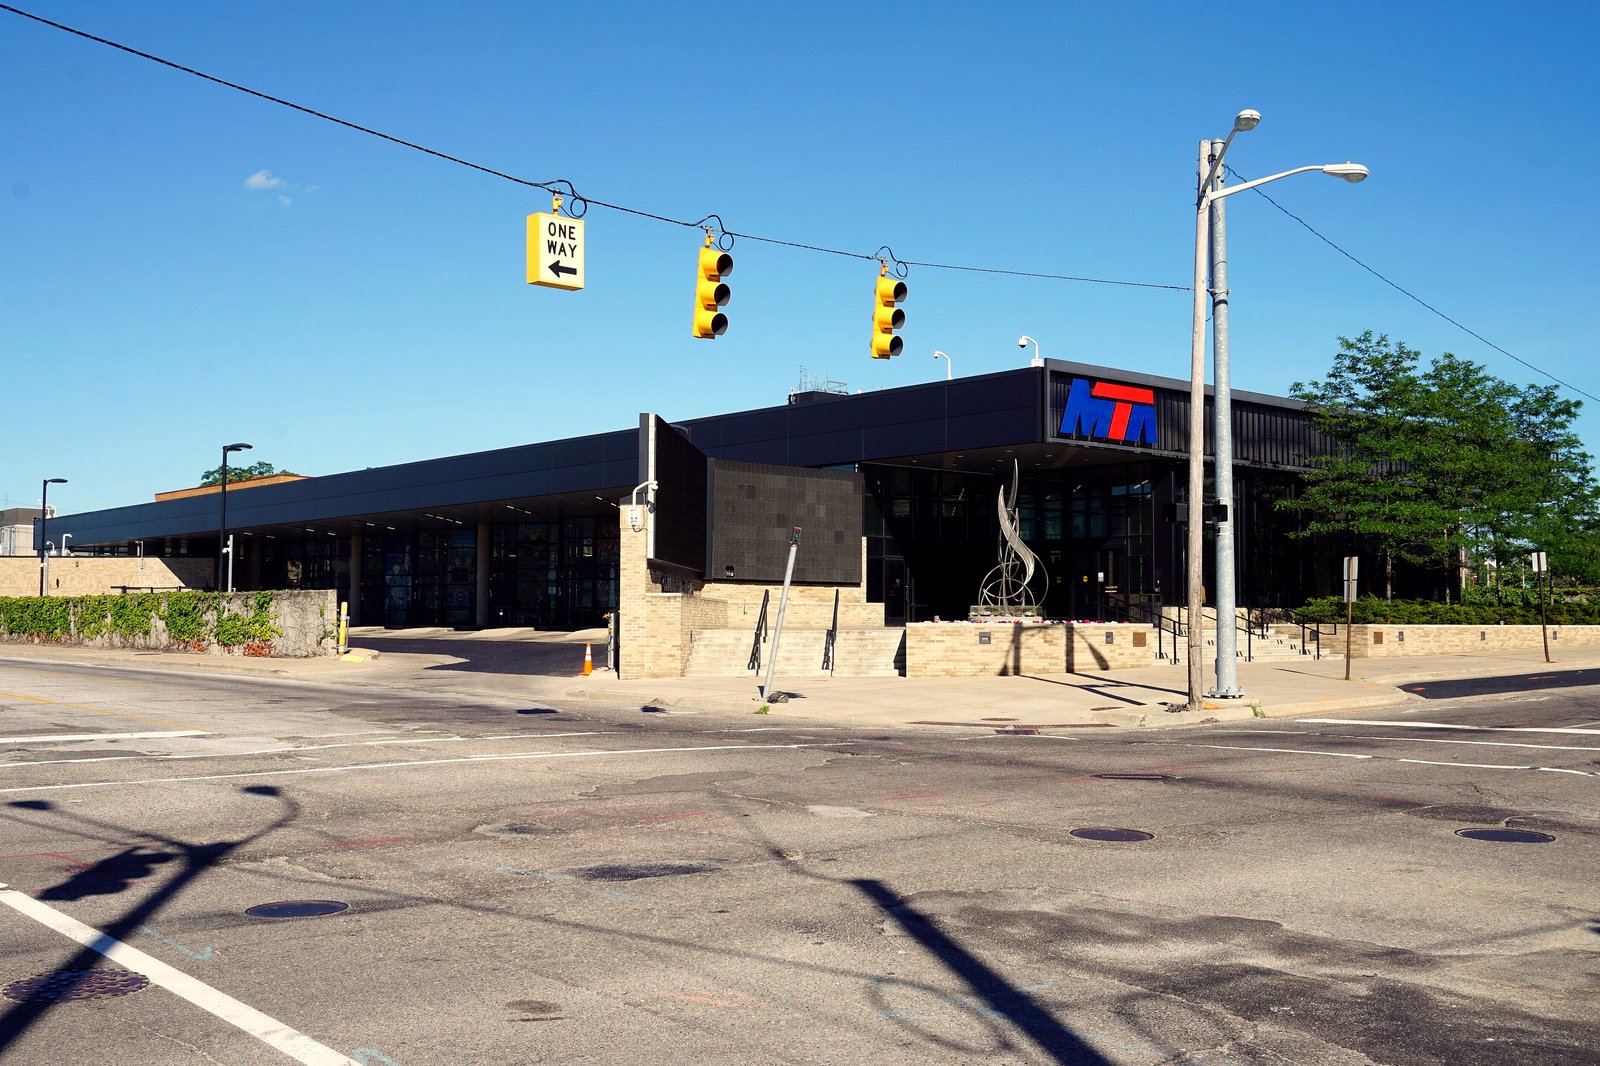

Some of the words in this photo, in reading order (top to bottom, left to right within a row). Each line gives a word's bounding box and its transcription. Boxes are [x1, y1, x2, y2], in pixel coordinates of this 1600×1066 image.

[548, 222, 576, 240] ONE
[547, 239, 577, 258] WAY
[1060, 378, 1158, 444] MTA
